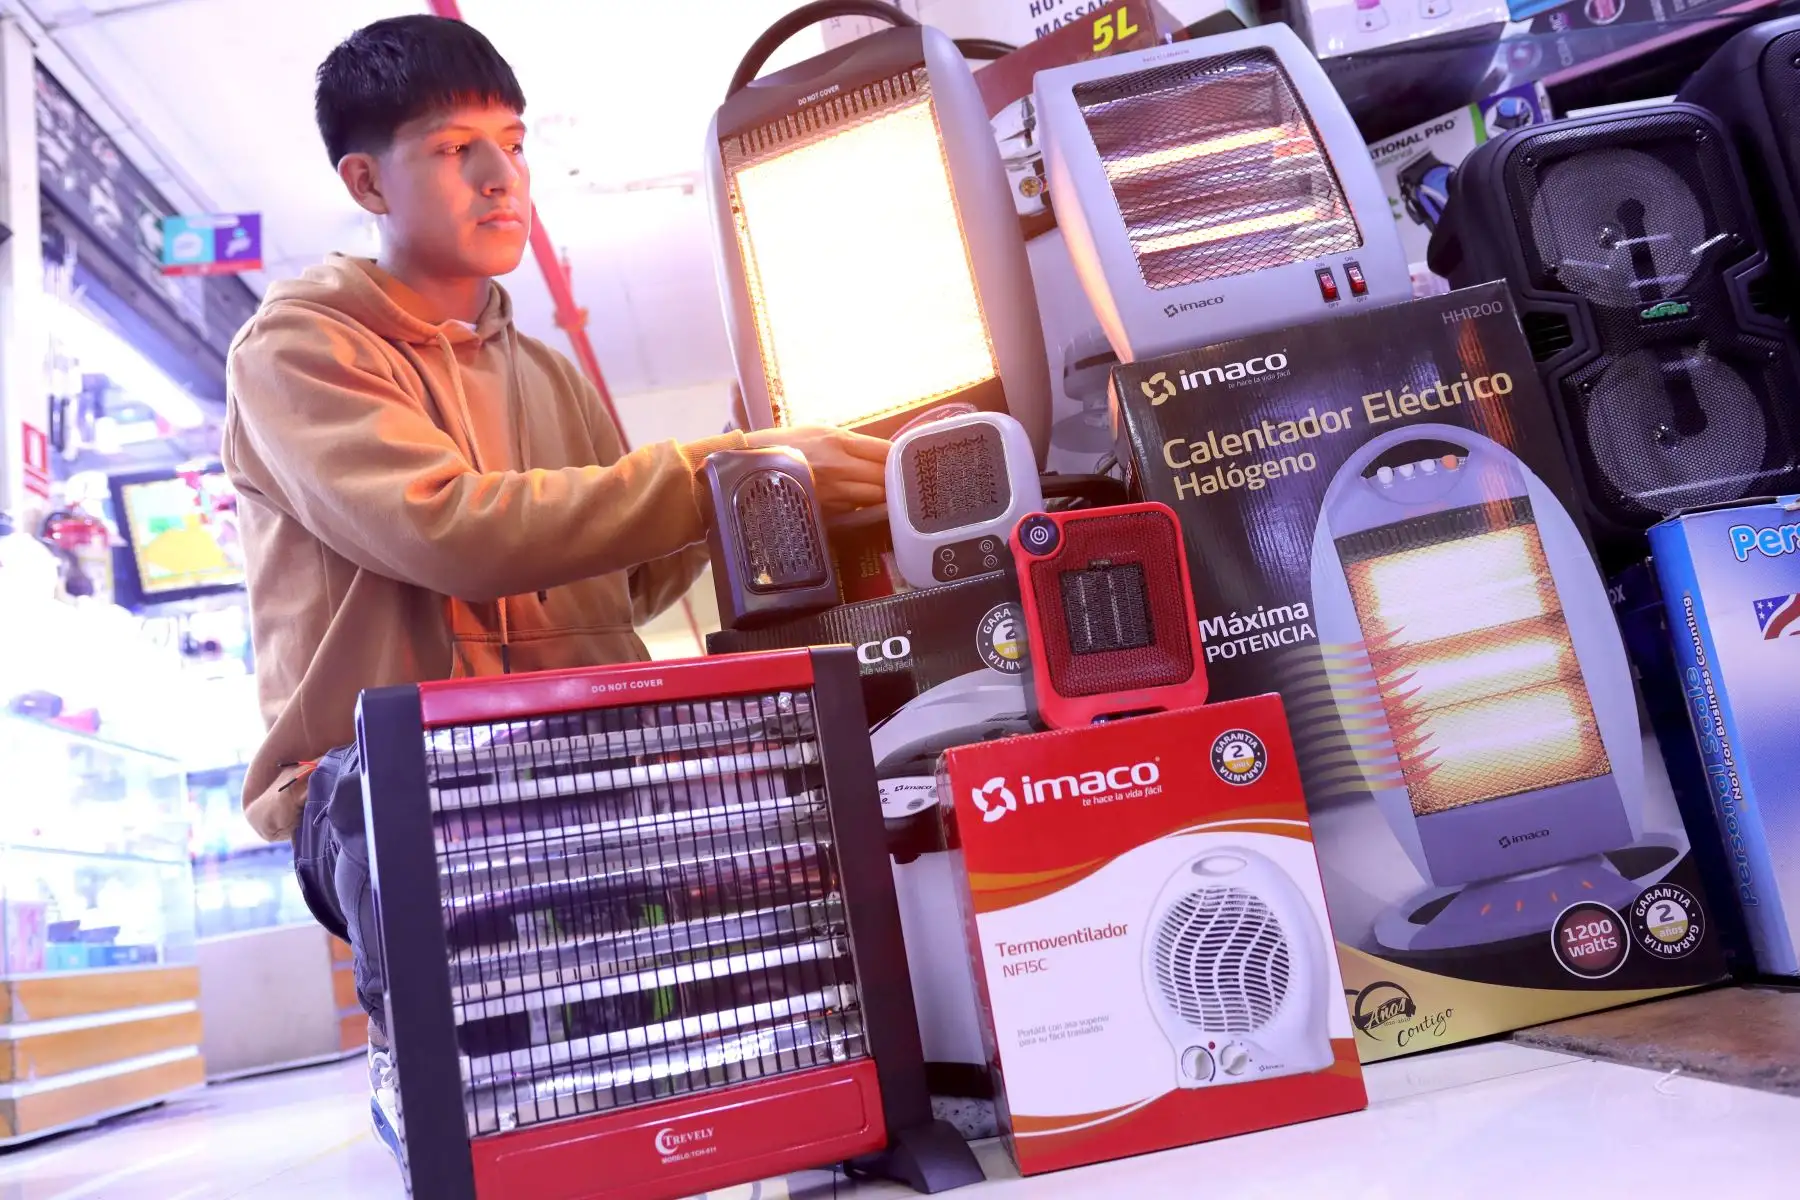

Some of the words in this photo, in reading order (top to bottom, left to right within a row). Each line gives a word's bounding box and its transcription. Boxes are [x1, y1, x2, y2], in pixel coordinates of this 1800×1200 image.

[1029, 0, 1063, 18] HO
[1093, 6, 1138, 52] 5L
[798, 98, 806, 106] DO
[807, 92, 818, 102] NOT
[820, 84, 840, 97] COVER
[1424, 119, 1455, 138] PRO
[1180, 296, 1224, 312] imaco
[1441, 300, 1503, 325] HH1200
[1179, 353, 1288, 391] imaco
[1163, 406, 1353, 469] Calentador
[1362, 371, 1514, 424] Eléctrico
[1174, 451, 1317, 500] Halógeno
[1198, 602, 1310, 643] Máxima
[1683, 596, 1706, 666] Counting
[1205, 623, 1317, 663] POTENCIA
[591, 685, 606, 694] DO
[608, 682, 628, 692] NOT
[629, 678, 664, 689] COVER
[1686, 665, 1719, 755] Scale
[1702, 669, 1726, 737] Business
[1215, 732, 1258, 754] GARANTIA
[1231, 744, 1245, 759] 2
[1021, 760, 1160, 805] imaco
[1219, 760, 1263, 782] GARANTIA
[1082, 797, 1091, 807] te
[1093, 794, 1114, 805] hace
[1115, 792, 1124, 800] la
[1125, 789, 1143, 799] vida
[1727, 771, 1743, 801] Not
[1511, 829, 1550, 844] imaco
[1708, 763, 1758, 909] Personal
[1635, 888, 1692, 917] GARANTIA
[1655, 903, 1675, 923] 2
[995, 922, 1128, 958] Termoventilador
[1563, 919, 1613, 943] 1200
[1644, 924, 1700, 954] GARANTIA
[1568, 936, 1618, 958] watts
[1002, 958, 1048, 978] NF15C
[663, 1126, 714, 1147] TREVELY
